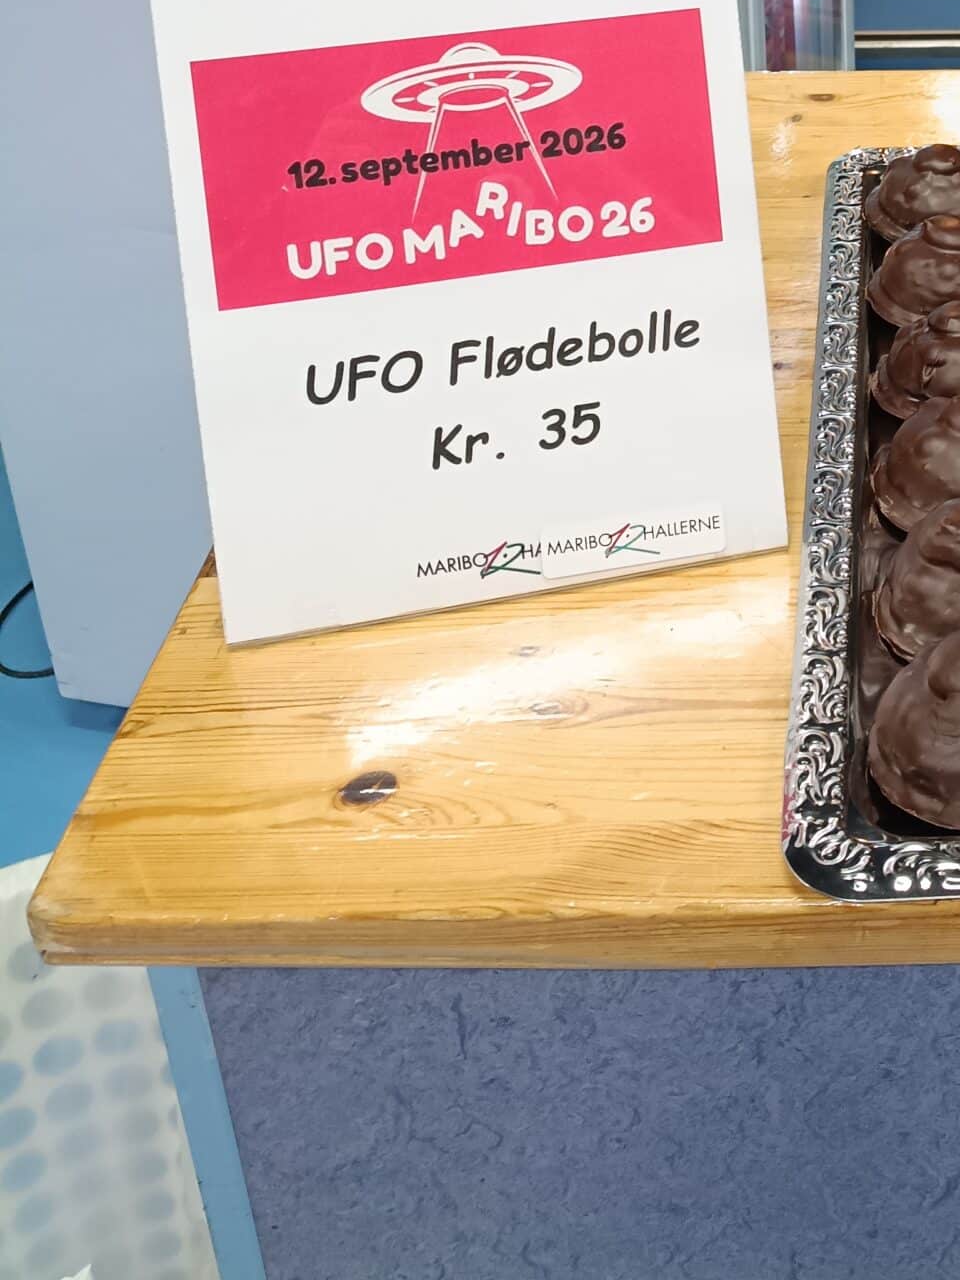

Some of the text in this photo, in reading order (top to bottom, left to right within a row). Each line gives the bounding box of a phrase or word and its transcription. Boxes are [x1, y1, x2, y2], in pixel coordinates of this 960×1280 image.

[540, 123, 627, 158] 2026
[287, 181, 655, 279] UFO MARIBO 26
[306, 309, 701, 405] UFO Flødebolle
[432, 402, 601, 470] Kr. 35
[547, 533, 612, 556] MARIBO
[643, 515, 721, 541] HALLERNE
[417, 552, 488, 578] MARIBO
